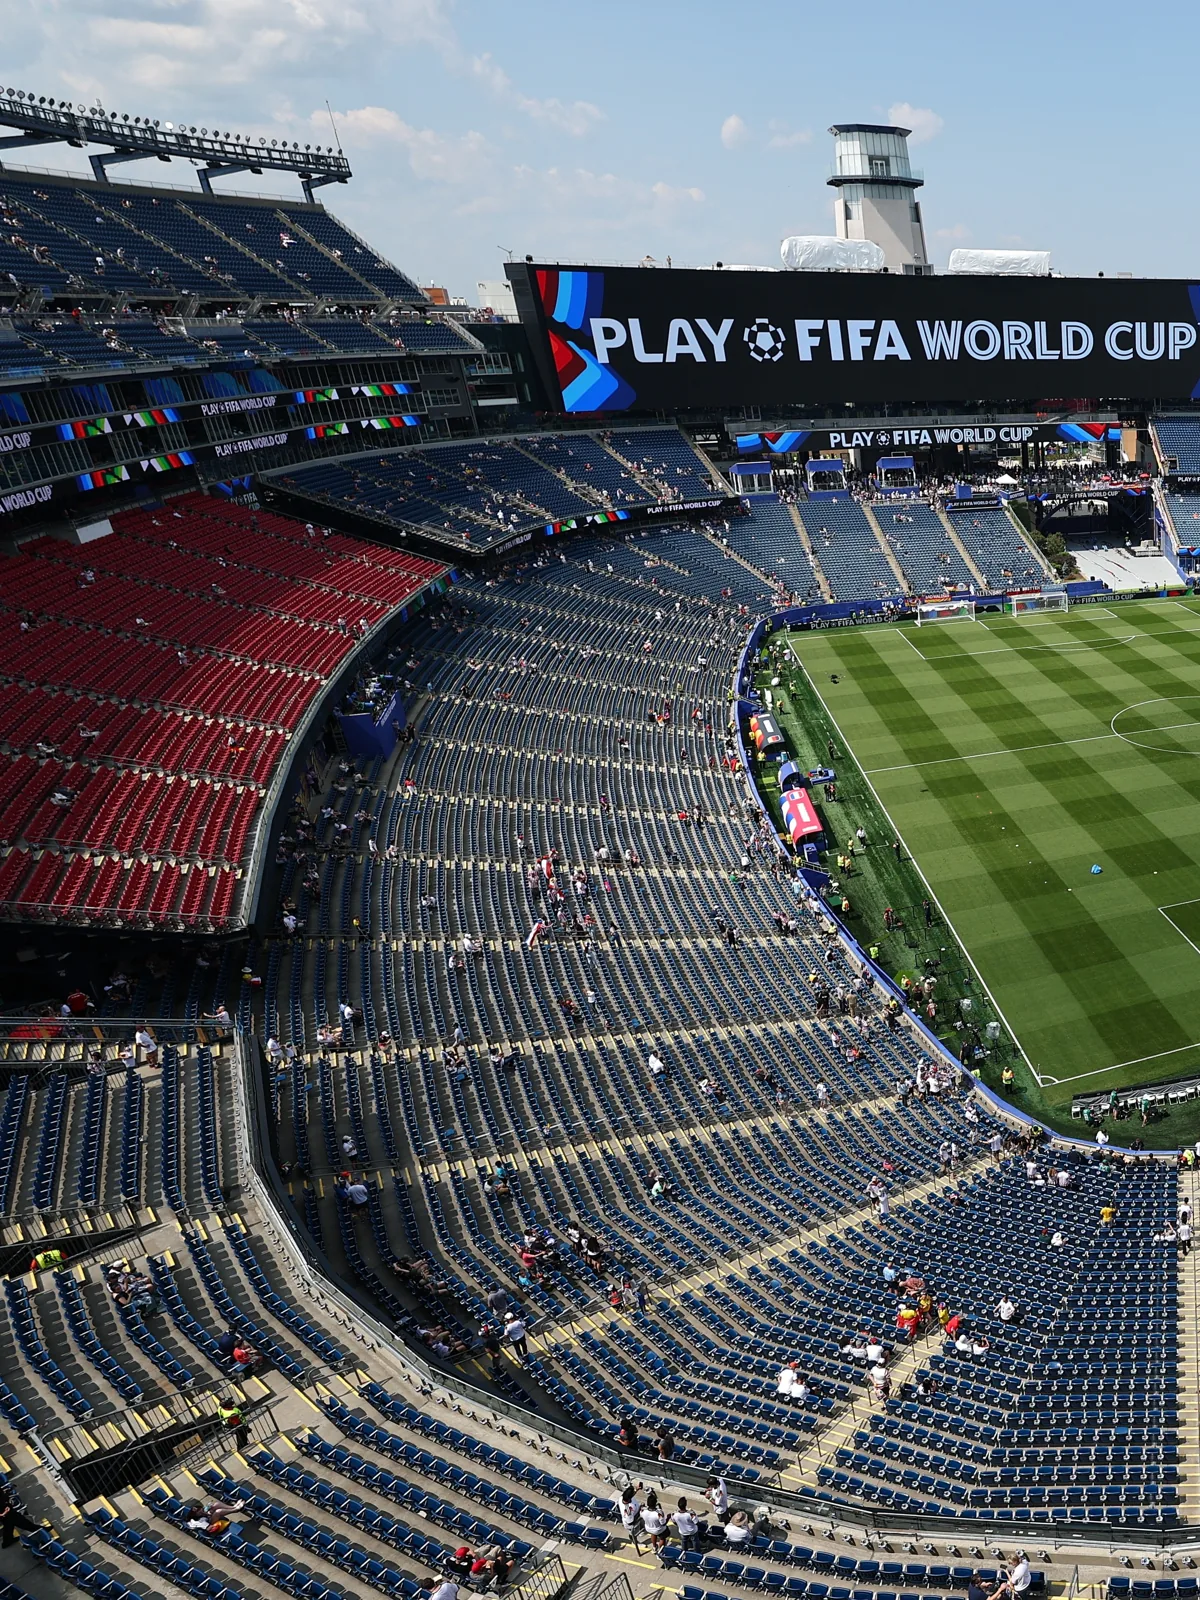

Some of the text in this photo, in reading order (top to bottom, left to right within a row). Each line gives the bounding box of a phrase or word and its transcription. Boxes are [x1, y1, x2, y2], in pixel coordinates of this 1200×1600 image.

[589, 318, 734, 363] PLAY
[794, 319, 911, 361] FIFA
[916, 320, 1094, 360] WORLD
[201, 402, 220, 416] PLAY
[225, 401, 241, 413] FIFA
[239, 398, 263, 410] WORLD
[215, 443, 233, 457] PLAY
[238, 440, 253, 452] FIFA
[252, 437, 275, 449] WORLD
[830, 431, 874, 448] PLAY
[893, 430, 932, 445] FIFA
[934, 428, 996, 443] WORLD
[1, 490, 36, 511] WORLD
[647, 506, 663, 514] PLAY
[669, 504, 683, 512] FIFA
[684, 501, 707, 510] WORLD
[811, 622, 830, 630] PLAY
[856, 616, 882, 625] WORLD
